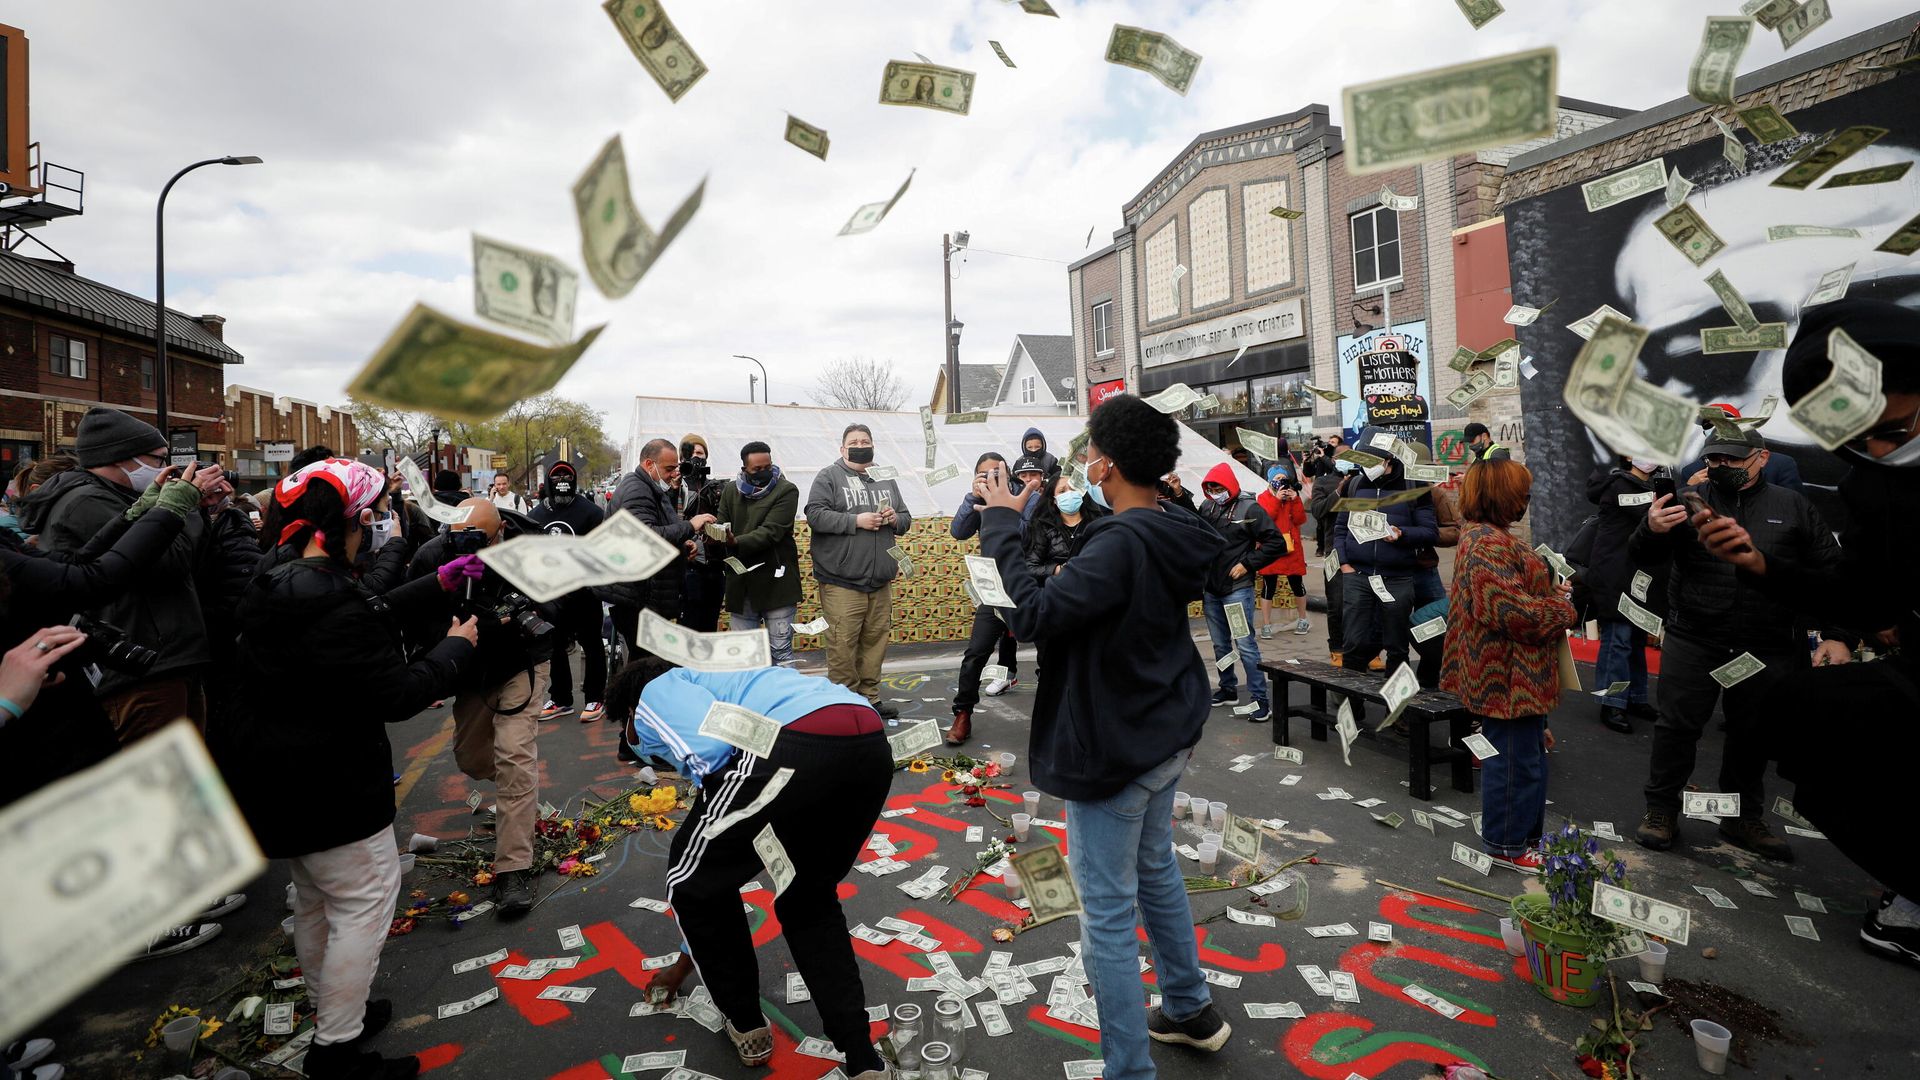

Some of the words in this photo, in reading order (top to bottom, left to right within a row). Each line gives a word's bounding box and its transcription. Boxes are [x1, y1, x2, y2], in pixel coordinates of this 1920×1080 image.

[1145, 342, 1174, 359] CHICAGO
[1231, 322, 1254, 339] ARTS
[1257, 312, 1295, 334] CENTER
[1342, 335, 1373, 364] HEAT
